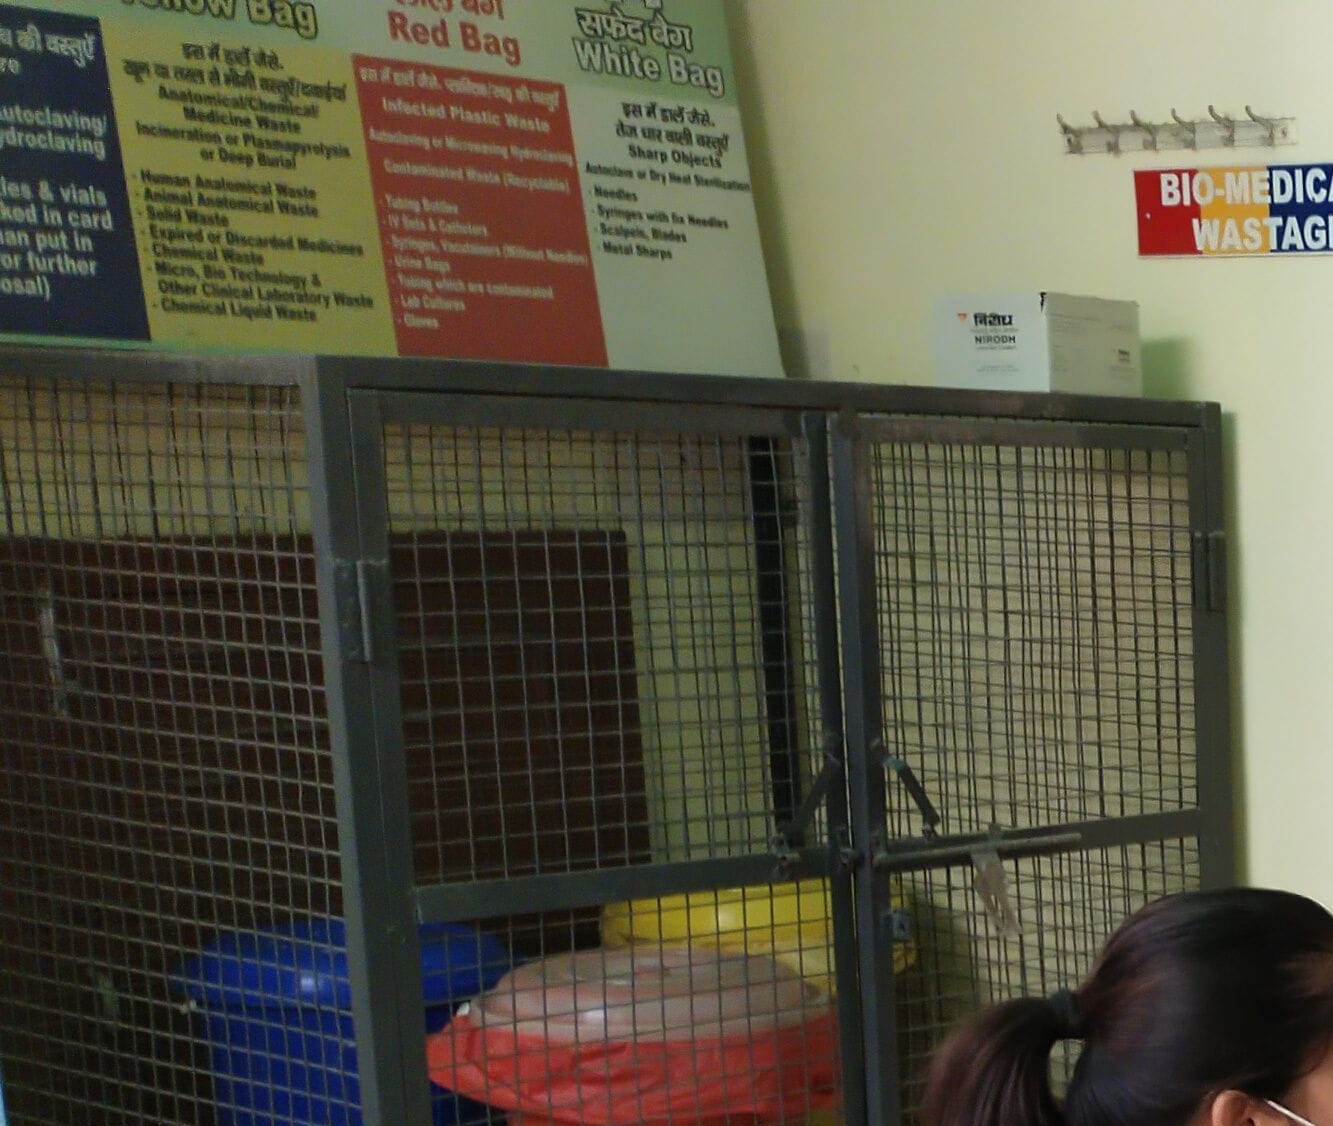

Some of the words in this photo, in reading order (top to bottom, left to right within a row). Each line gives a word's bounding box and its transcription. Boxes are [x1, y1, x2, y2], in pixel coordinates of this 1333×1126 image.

[388, 9, 450, 48] Red
[459, 21, 521, 66] Bag
[572, 37, 661, 82] White
[667, 52, 725, 99] Bag
[0, 104, 107, 138] utoclaving/
[183, 105, 251, 129] Medicine
[255, 114, 301, 134] Waste
[383, 97, 446, 120] Infected
[450, 105, 500, 126] Plastic
[505, 113, 550, 132] Waste
[218, 147, 254, 167] Deep
[257, 151, 296, 169] Burial
[628, 144, 669, 164] Sharp
[671, 149, 722, 169] Objects
[59, 183, 108, 208] vials
[141, 169, 190, 187] Human
[196, 174, 272, 195] Anatomical
[274, 183, 317, 200] Waste
[594, 184, 638, 202] Needles
[0, 202, 38, 225] ked
[42, 203, 63, 227] in
[68, 209, 114, 232] card
[186, 208, 229, 228] Waste
[277, 201, 319, 218] Waste
[646, 211, 670, 225] with
[687, 212, 729, 231] Needles
[35, 229, 69, 254] put
[73, 229, 94, 252] in
[152, 241, 218, 262] Chemical
[222, 249, 264, 267] Waste
[602, 240, 634, 256] Metal
[635, 244, 673, 261] Sharps
[27, 250, 98, 277] further
[0, 274, 51, 301] osal)
[158, 279, 197, 296] Other
[333, 291, 374, 309] Waste
[161, 298, 227, 317] Chemical
[231, 302, 273, 321] Liquid
[274, 304, 317, 323] Waste
[974, 335, 1016, 344] NIRODH
